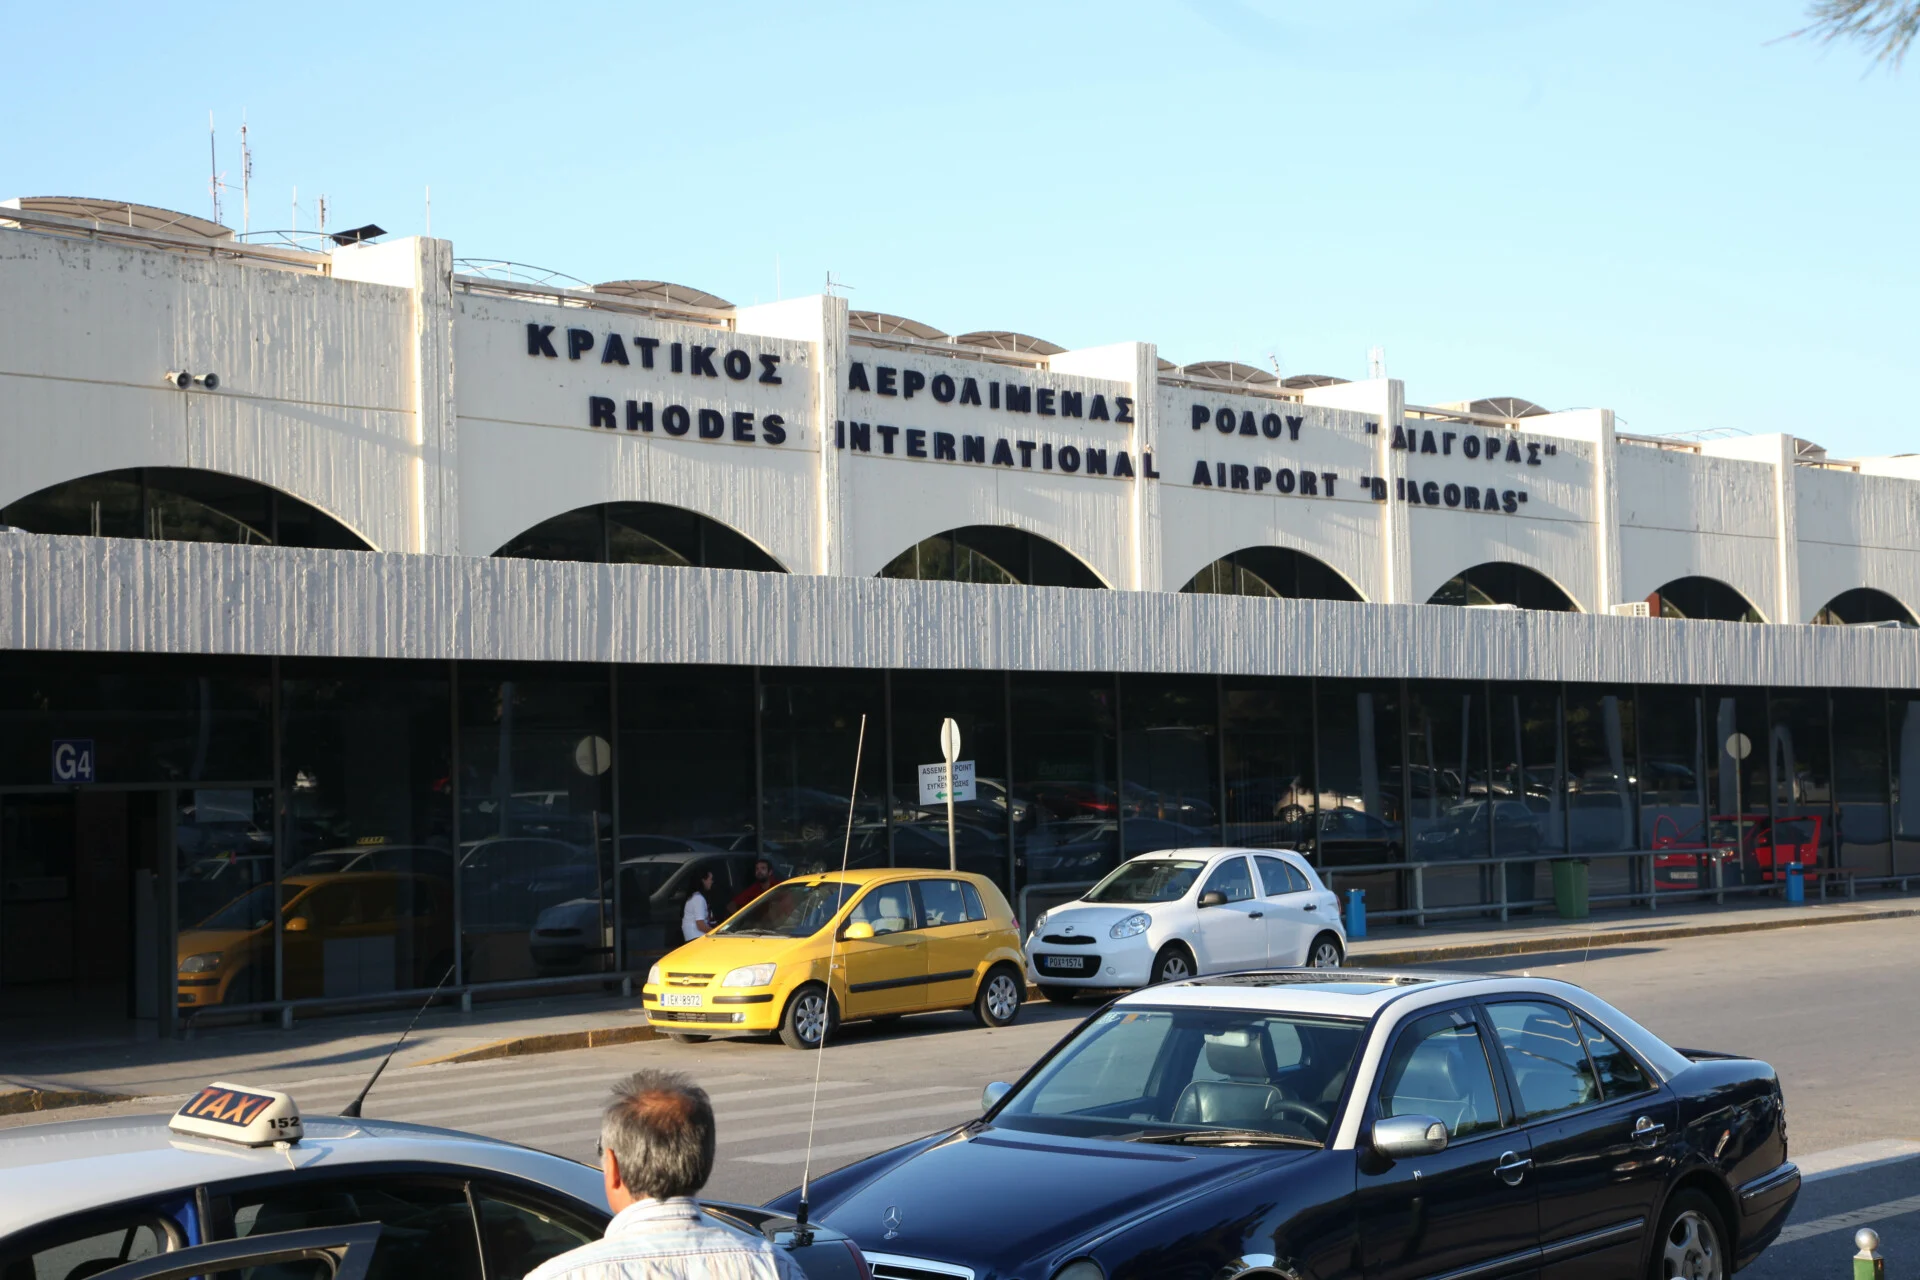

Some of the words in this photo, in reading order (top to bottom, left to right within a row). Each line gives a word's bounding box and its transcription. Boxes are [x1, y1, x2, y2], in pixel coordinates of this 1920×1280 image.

[527, 323, 782, 385] ΚΡΑΤΙΚΟΣ
[849, 362, 1134, 424] ΑΕΡΟΛΙΜΕΝΑΣ
[1191, 404, 1303, 441] ΡΟΔΟΥ
[589, 396, 786, 445] RHODES
[835, 420, 1160, 479] INTERNATIONAL
[1192, 460, 1338, 497] AIRPORT
[55, 743, 91, 780] G4
[922, 766, 954, 774] ASSEMB
[955, 763, 972, 771] POINT
[187, 1088, 273, 1125] TAXI
[267, 1116, 300, 1129] 152
